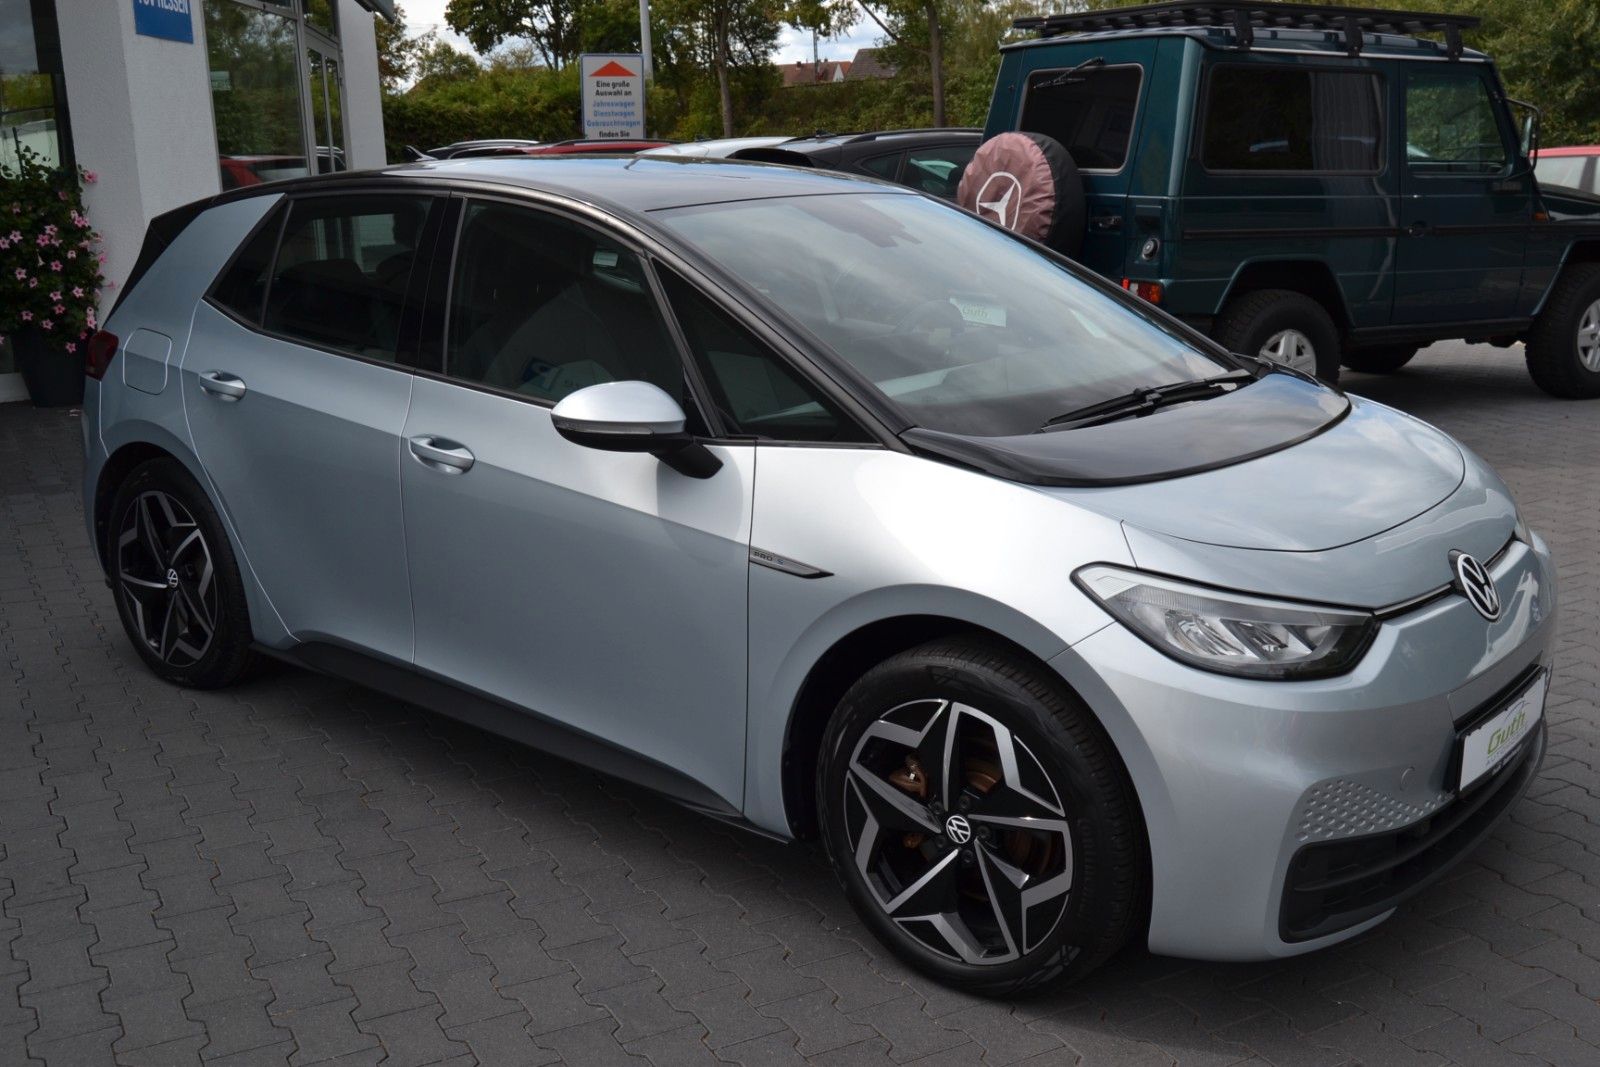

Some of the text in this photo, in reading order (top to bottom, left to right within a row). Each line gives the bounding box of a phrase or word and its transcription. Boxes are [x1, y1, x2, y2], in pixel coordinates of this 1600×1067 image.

[611, 81, 630, 89] große
[592, 101, 635, 109] Jahreswagen
[593, 110, 635, 118] Dienstwagen
[599, 130, 630, 138] finden Sie
[1487, 711, 1526, 755] Guth
